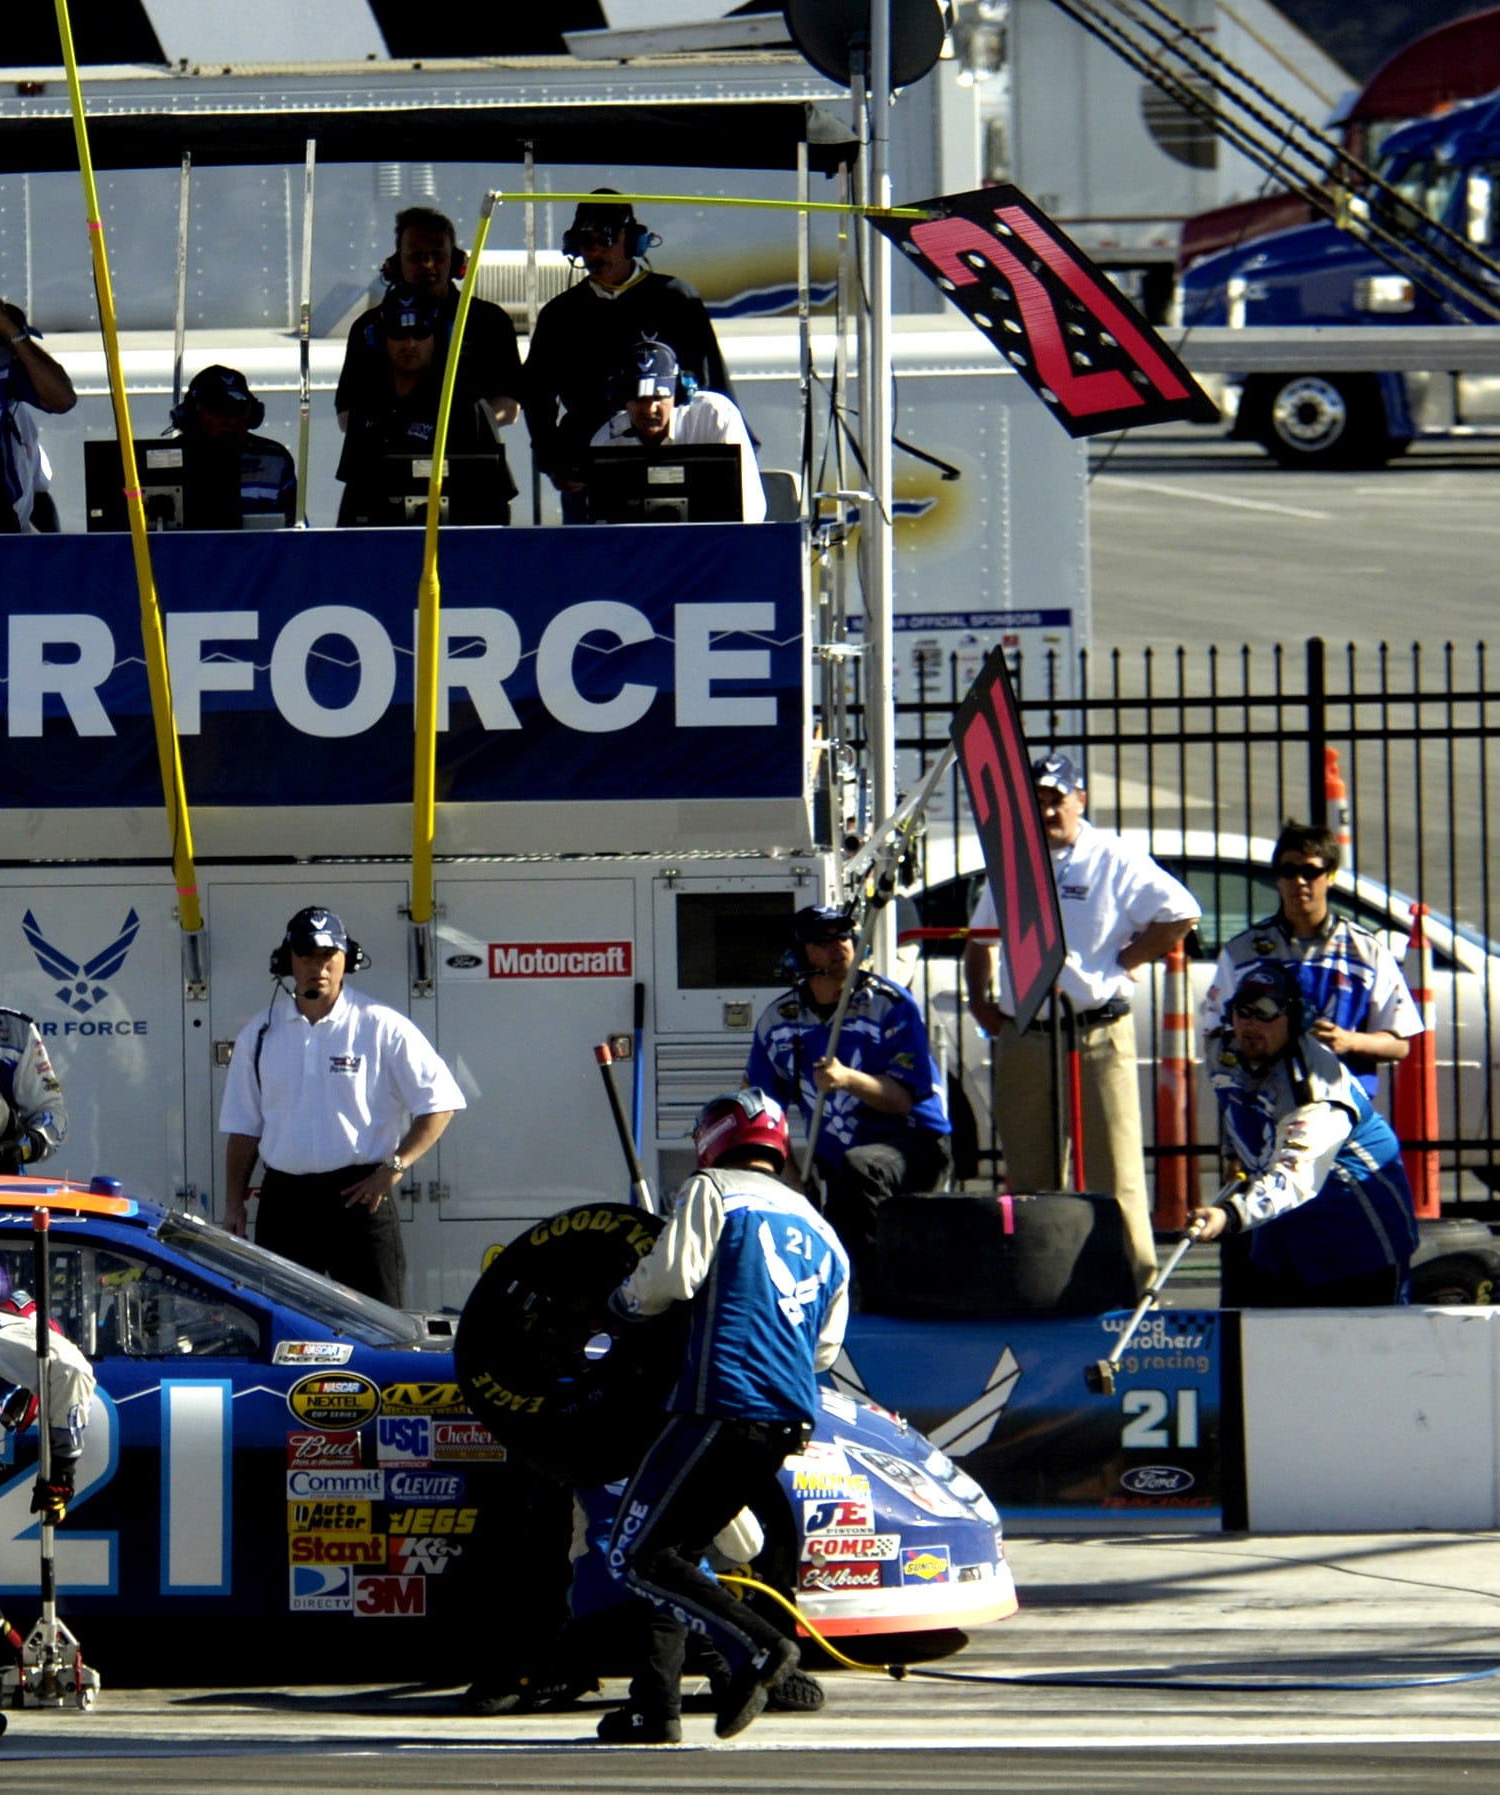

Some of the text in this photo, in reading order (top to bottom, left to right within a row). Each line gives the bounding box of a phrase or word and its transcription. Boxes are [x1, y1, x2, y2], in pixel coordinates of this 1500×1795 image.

[910, 205, 1191, 417] 21
[164, 600, 778, 736] FORCE
[964, 677, 1056, 1004] 21
[493, 946, 627, 975] Motorcraft
[37, 1020, 148, 1036] IR FORCE
[786, 1225, 813, 1261] 21
[1102, 1315, 1165, 1333] wod
[1144, 1352, 1210, 1374] racing
[322, 1382, 361, 1393] NASCAR
[471, 1371, 546, 1415] EAGLE
[306, 1396, 361, 1408] NEXTEL
[311, 1410, 329, 1419] CUP
[1121, 1388, 1199, 1449] 21
[290, 1437, 359, 1458] Bud
[379, 1417, 429, 1458] USG
[289, 1471, 381, 1495] Commit
[390, 1473, 460, 1495] CLEVITE
[793, 1473, 870, 1491] MOOG
[1134, 1470, 1180, 1489] Ford
[312, 1503, 357, 1517] Auto
[389, 1508, 479, 1534] JEGS
[807, 1502, 867, 1534] JE
[309, 1516, 366, 1530] Meter
[291, 1536, 383, 1563] Stant
[609, 1500, 650, 1581] FORCE
[808, 1539, 877, 1555] COMP
[854, 1550, 887, 1558] CAMS
[802, 1566, 881, 1588] Edelbrock
[907, 1561, 948, 1572] SUNOCO
[293, 1599, 351, 1609] DIRECTV
[356, 1577, 425, 1615] 3M
